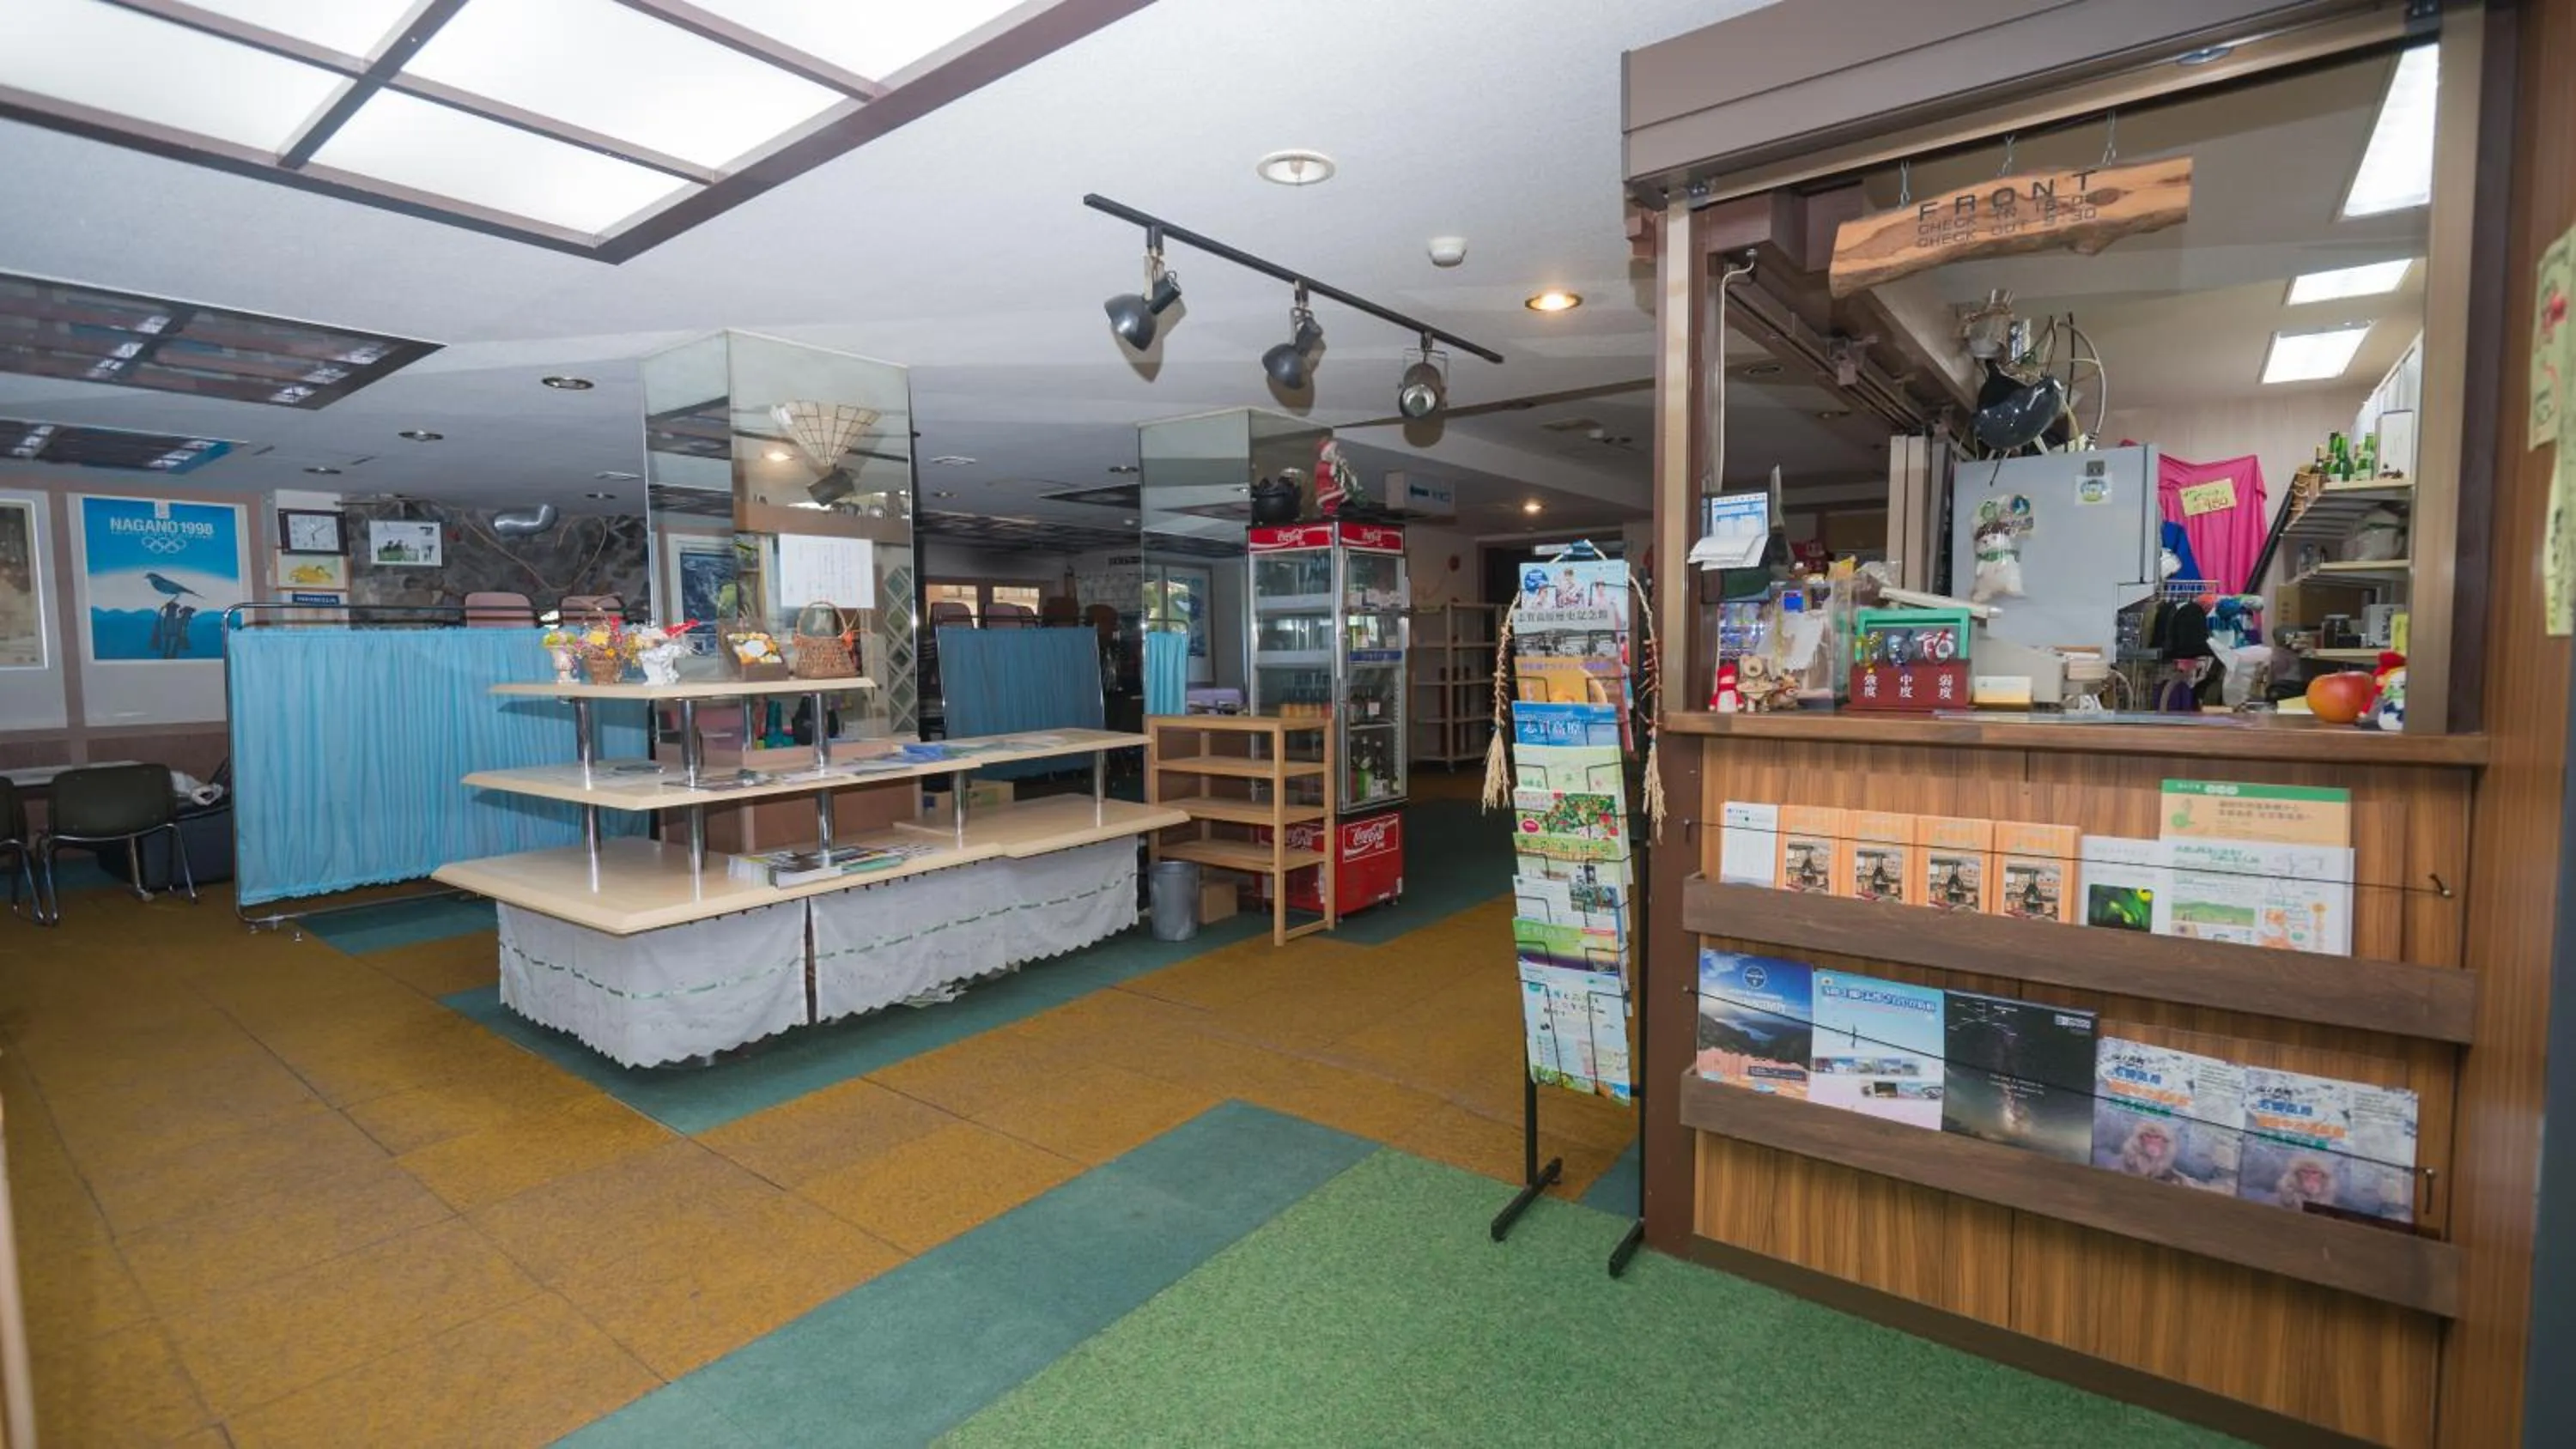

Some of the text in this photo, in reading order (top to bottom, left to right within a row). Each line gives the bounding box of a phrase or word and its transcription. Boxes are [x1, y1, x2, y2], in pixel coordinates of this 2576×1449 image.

[1919, 170, 2098, 221] FRONT
[1916, 230, 1977, 248] CHECK
[1991, 221, 2027, 236] OUT
[1917, 216, 1977, 236] CHECK
[1995, 206, 2018, 221] IN
[110, 517, 178, 534] NAGANO
[180, 521, 214, 536] 1998
